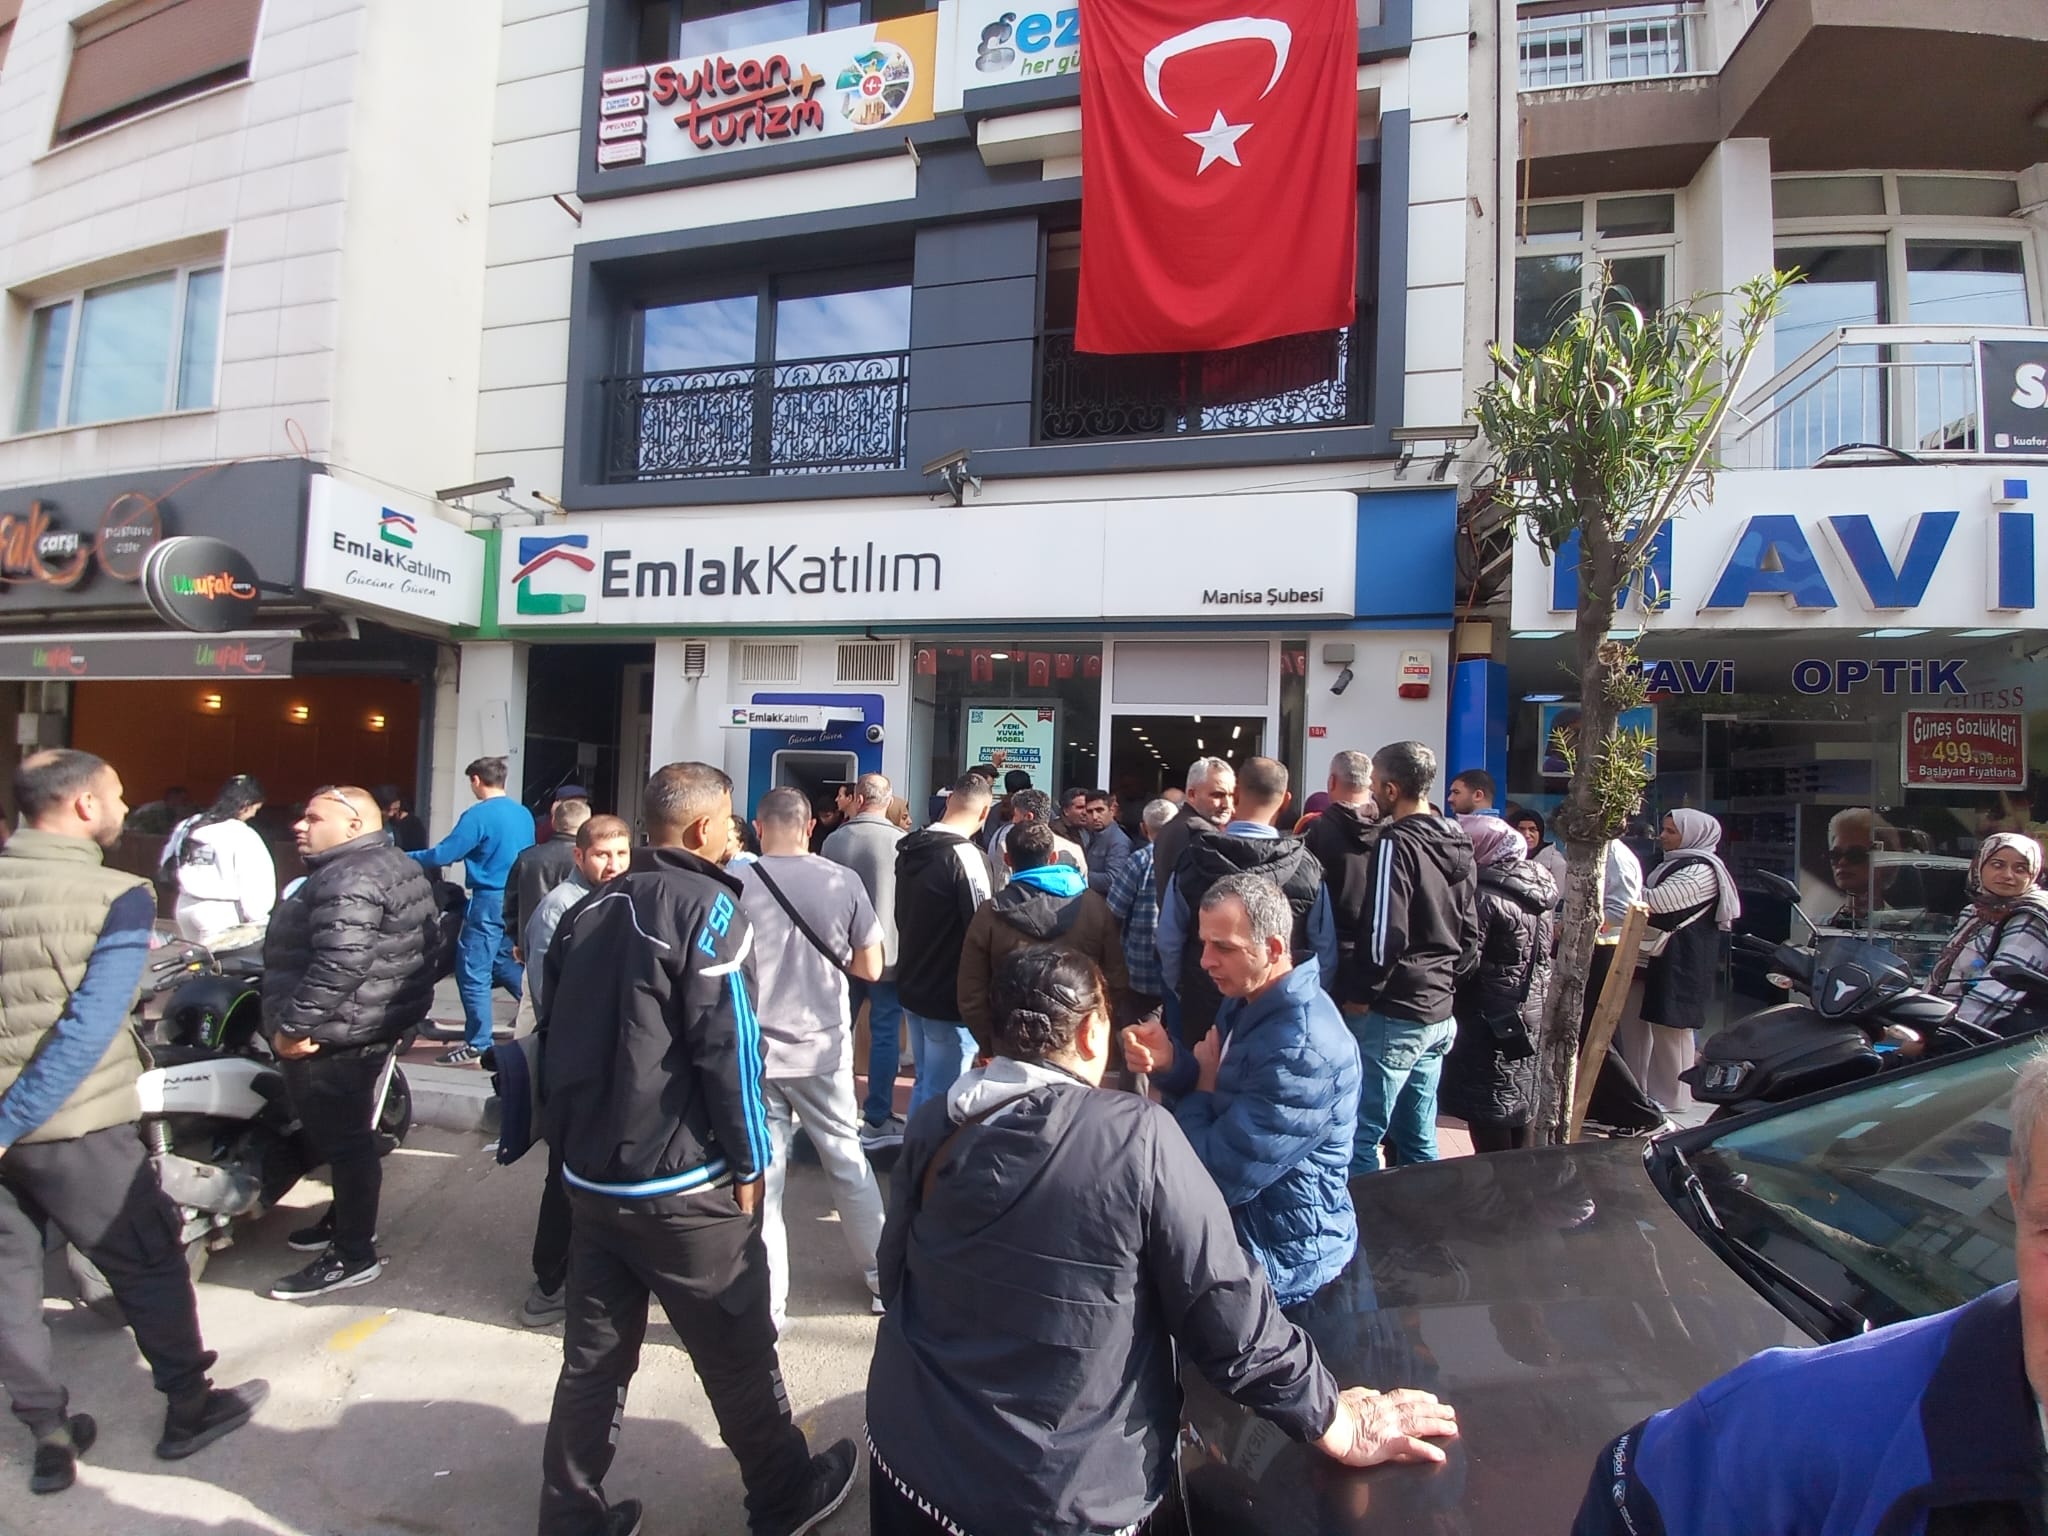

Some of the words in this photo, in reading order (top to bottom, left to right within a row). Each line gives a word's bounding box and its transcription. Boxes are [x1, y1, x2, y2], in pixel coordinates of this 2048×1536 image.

[1020, 58, 1054, 76] her
[653, 55, 791, 106] Sultan
[689, 97, 824, 149] turizm
[2012, 363, 2048, 409] S
[2013, 436, 2048, 447] kuafor
[39, 533, 79, 555] çarşı
[333, 531, 451, 584] EmlakKatılım
[601, 541, 941, 598] EmlakKatılım
[1203, 589, 1262, 604] Manisa
[1266, 588, 1324, 606] Şubesi
[748, 712, 809, 723] EmlakKatılım
[1919, 765, 1966, 779] Başlayan
